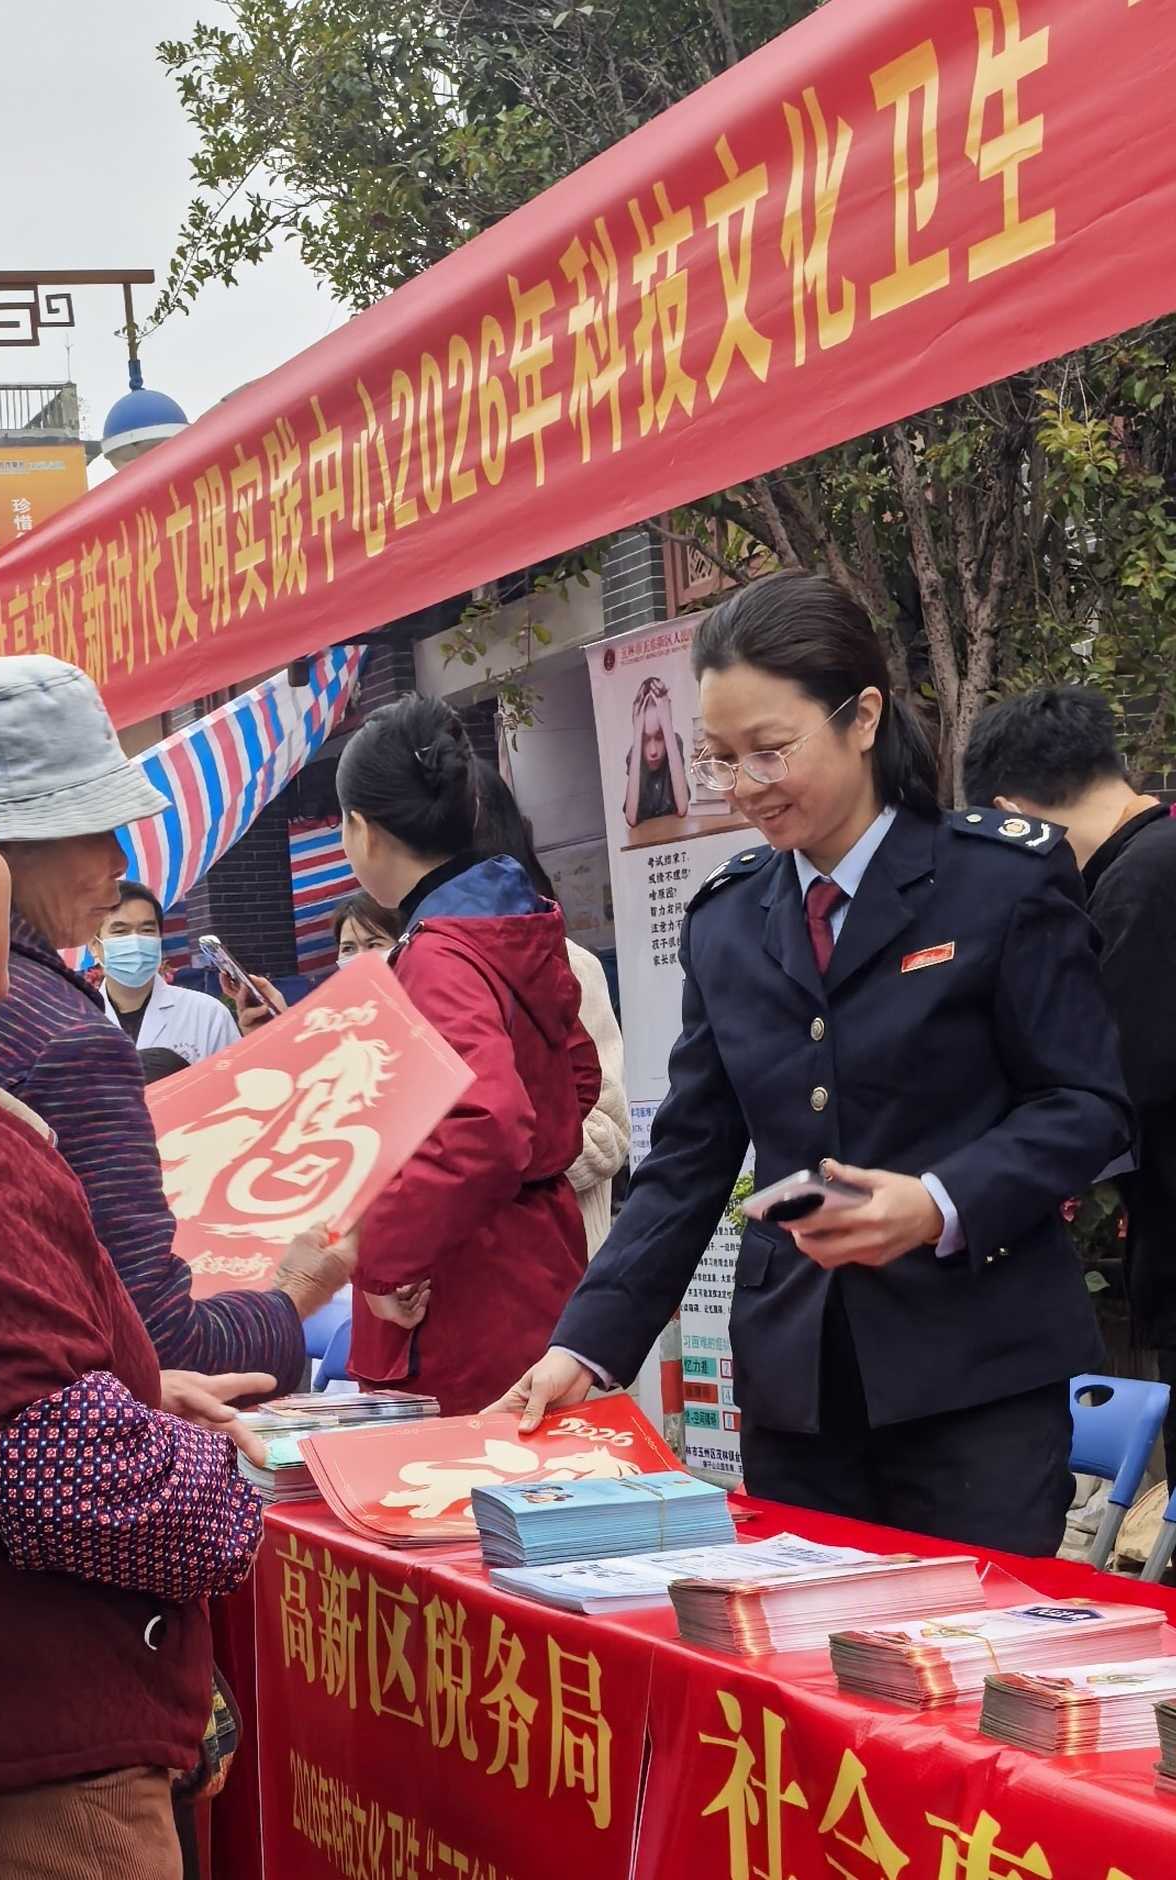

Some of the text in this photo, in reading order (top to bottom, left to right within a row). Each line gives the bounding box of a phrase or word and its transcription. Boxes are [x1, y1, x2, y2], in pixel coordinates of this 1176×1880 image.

[11, 498, 33, 539] 珍惜
[546, 1417, 635, 1447] 2026
[275, 1533, 612, 1830] 高新区税务局
[699, 1690, 1134, 1880] 社会
